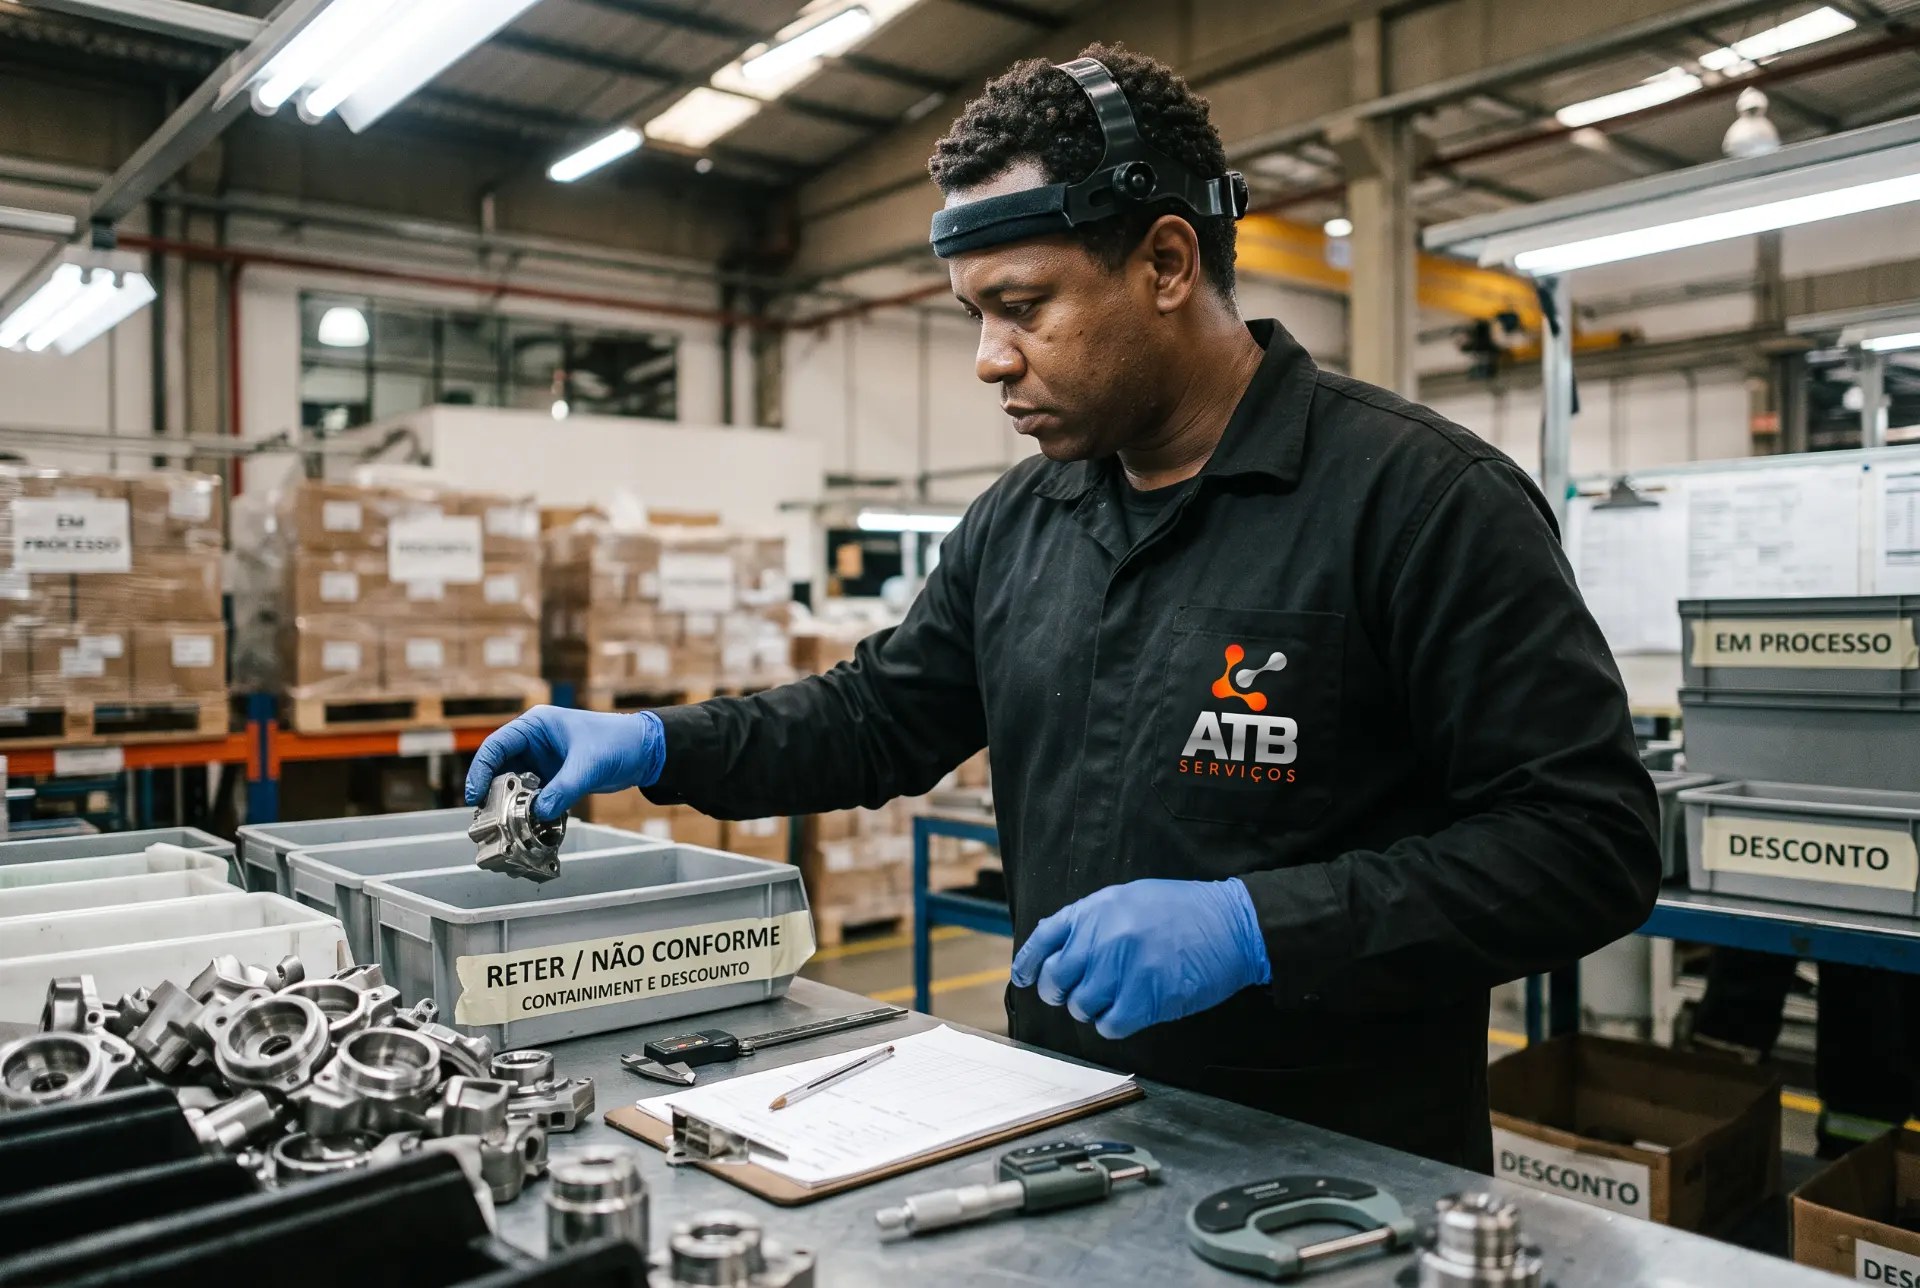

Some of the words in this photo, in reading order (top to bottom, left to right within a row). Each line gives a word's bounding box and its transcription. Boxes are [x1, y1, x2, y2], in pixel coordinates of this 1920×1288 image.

[57, 515, 84, 529] EM
[23, 537, 121, 553] PROCESSO
[1715, 633, 1751, 652] EM
[1760, 633, 1892, 653] PROCESSO
[1181, 711, 1298, 765] ATB
[1179, 759, 1296, 783] SERVIÇOS
[1729, 835, 1889, 871] DESCONTO
[487, 955, 565, 989] RETER
[571, 949, 584, 981] /
[592, 941, 645, 972] NÃO
[652, 925, 780, 963] CONFORME
[522, 978, 643, 1011] CONTAINIMENT
[648, 976, 656, 990] E
[661, 961, 750, 988] DESCOUNTO
[1501, 1149, 1640, 1206] DESCONTO
[1864, 1258, 1920, 1288] DES
